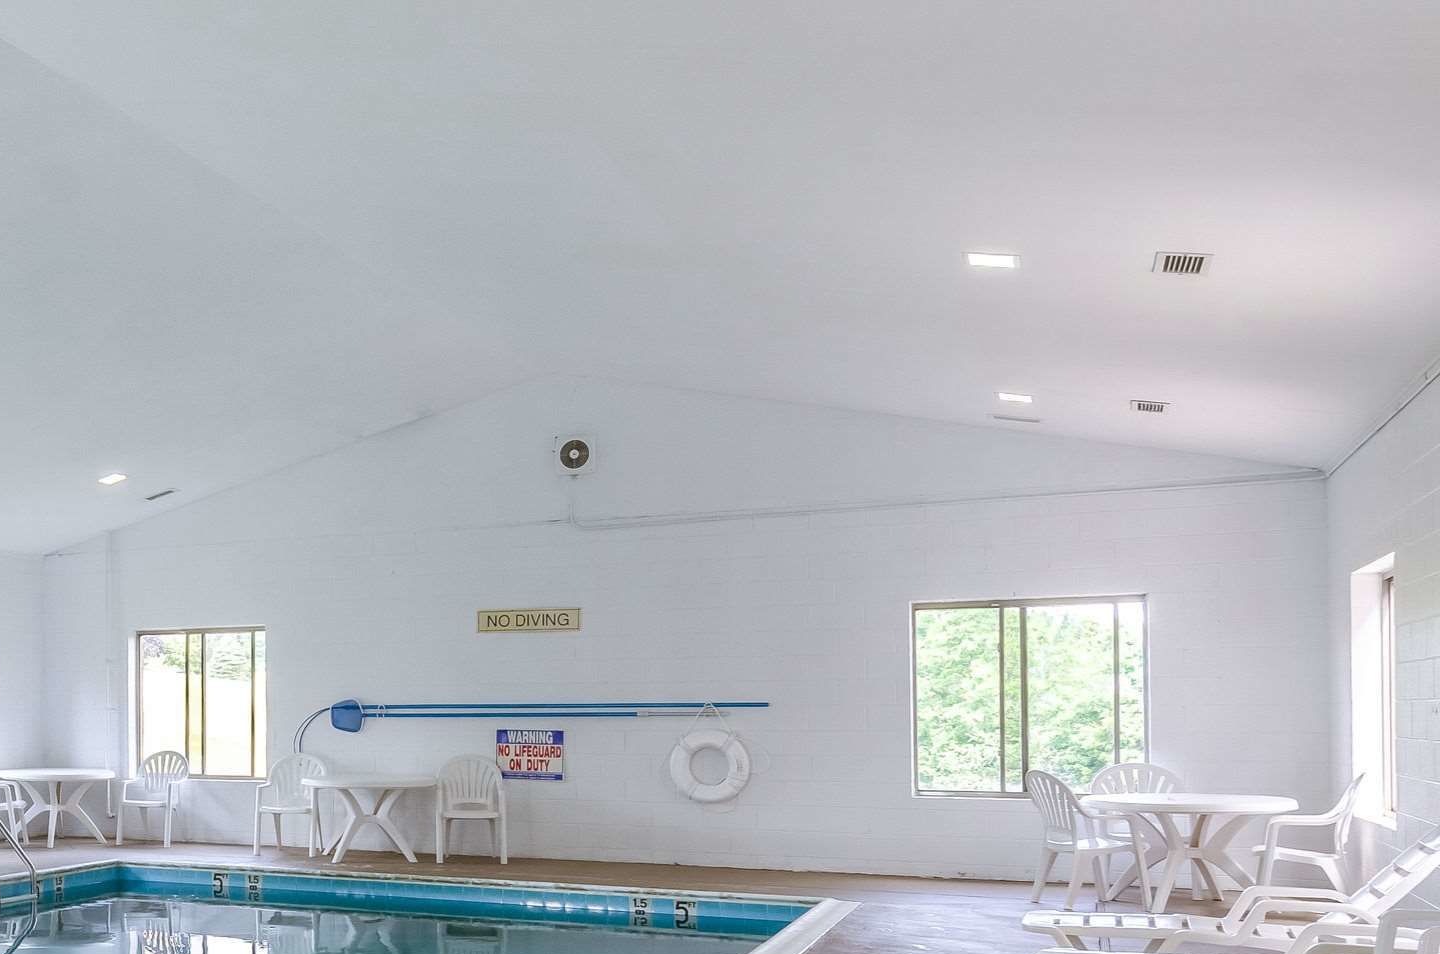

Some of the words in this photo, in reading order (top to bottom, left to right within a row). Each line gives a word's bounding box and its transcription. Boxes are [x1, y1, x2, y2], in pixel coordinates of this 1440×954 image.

[487, 614, 510, 628] NO
[515, 613, 570, 627] DIVING
[507, 730, 553, 745] WARNING
[498, 745, 511, 757] NO
[514, 745, 562, 758] LIFEGUARD
[510, 758, 521, 771] ON
[526, 758, 550, 771] DUTY
[633, 898, 648, 908] 1.5
